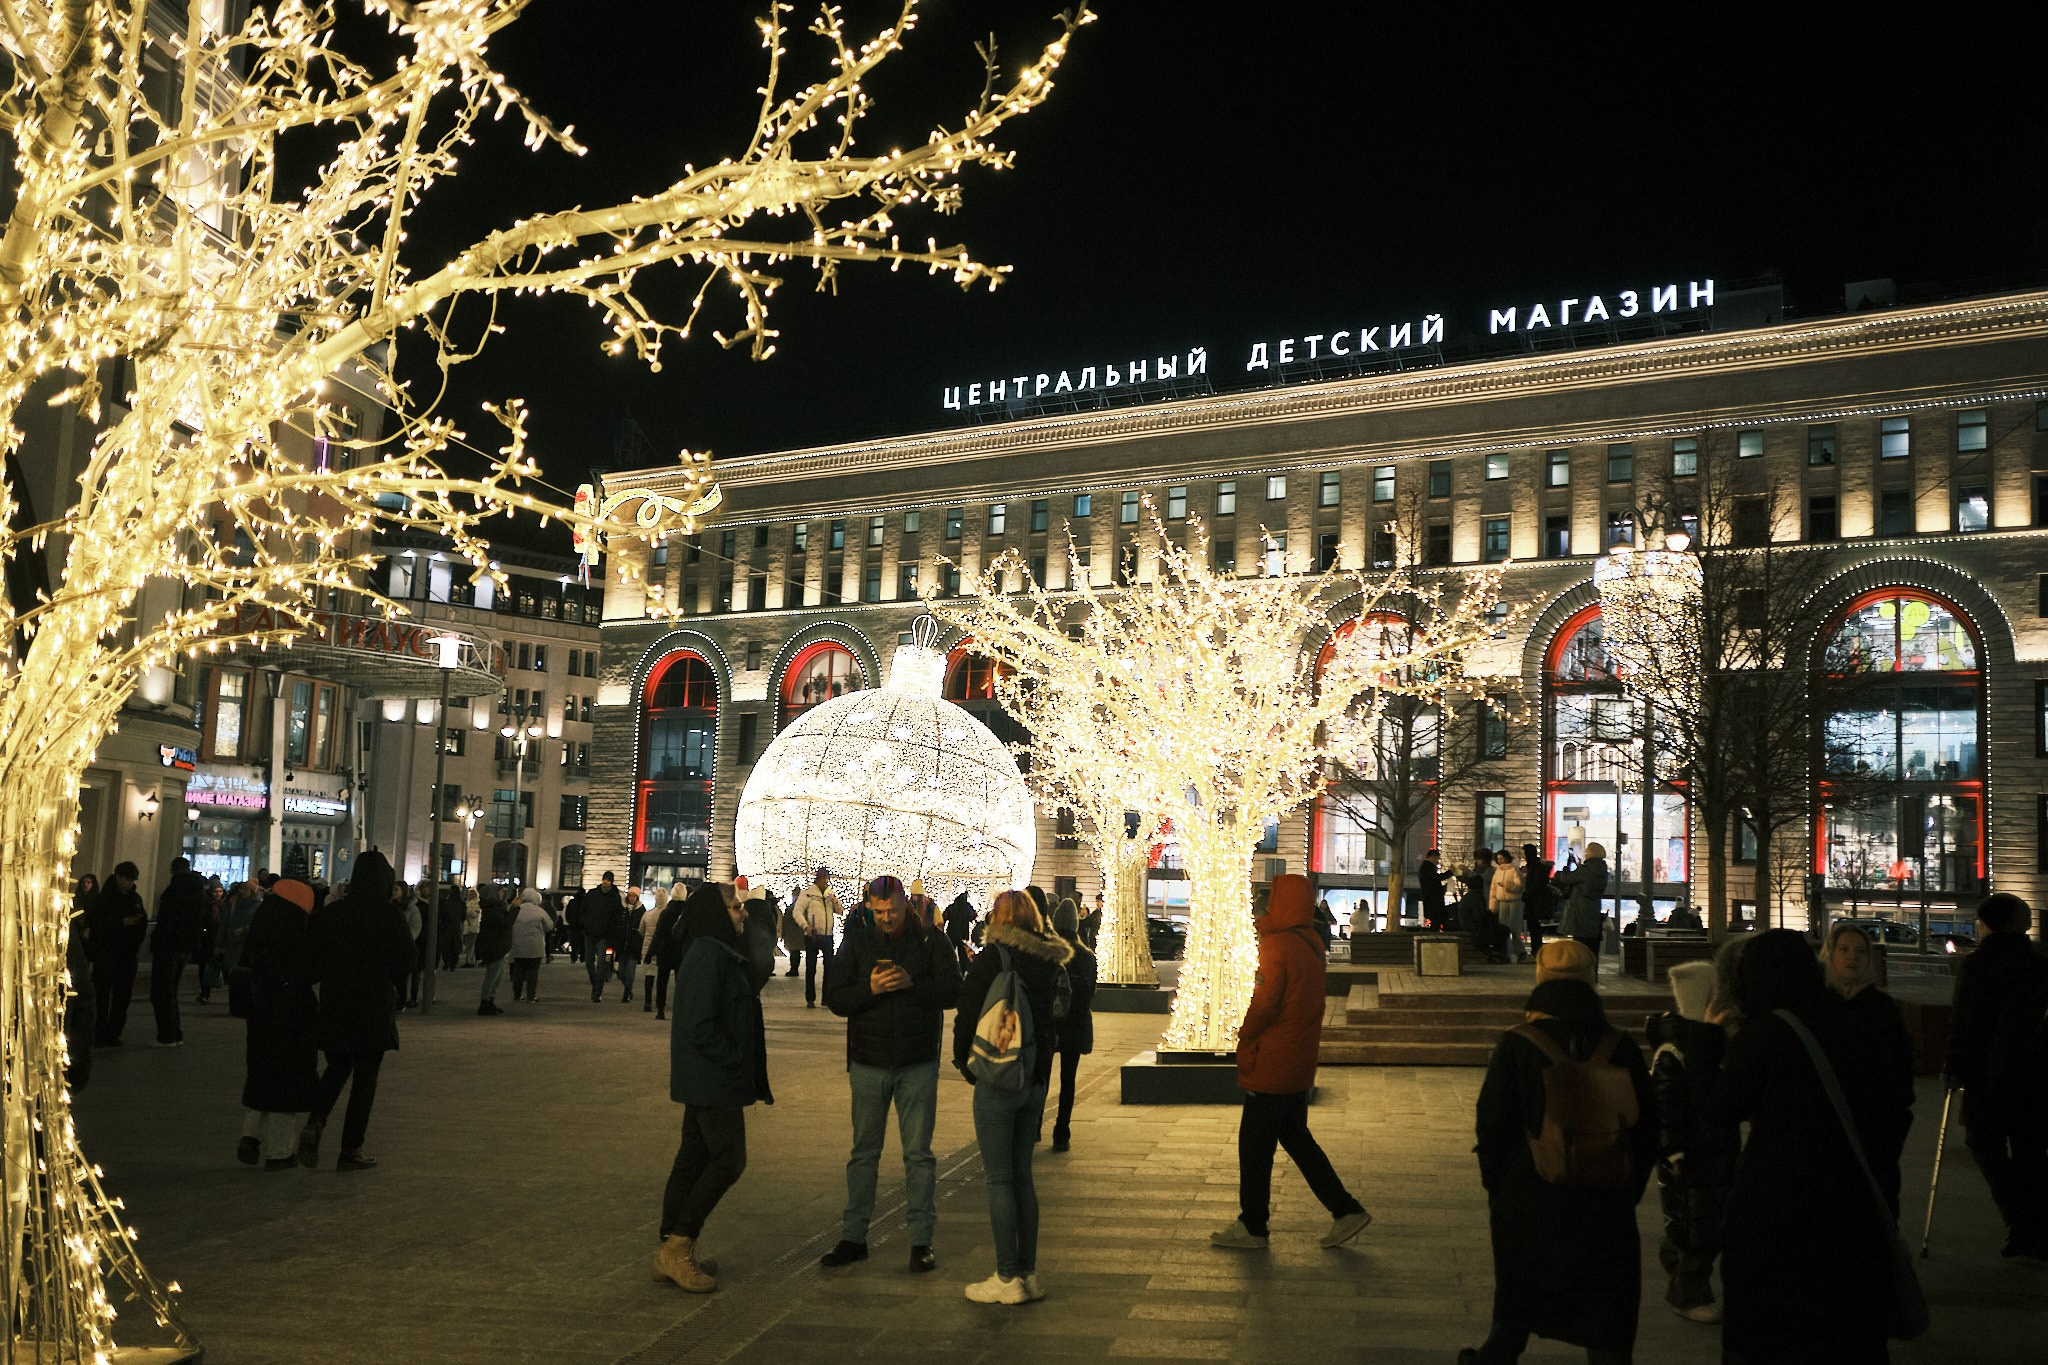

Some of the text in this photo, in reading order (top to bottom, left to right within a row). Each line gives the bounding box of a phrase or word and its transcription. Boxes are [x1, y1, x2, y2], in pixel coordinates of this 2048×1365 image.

[943, 279, 1714, 411] ЦЕНТРАЛЬНЫЙ ДЕТСКИЙ МАГАЗИН
[216, 793, 267, 809] МАГАЗИН
